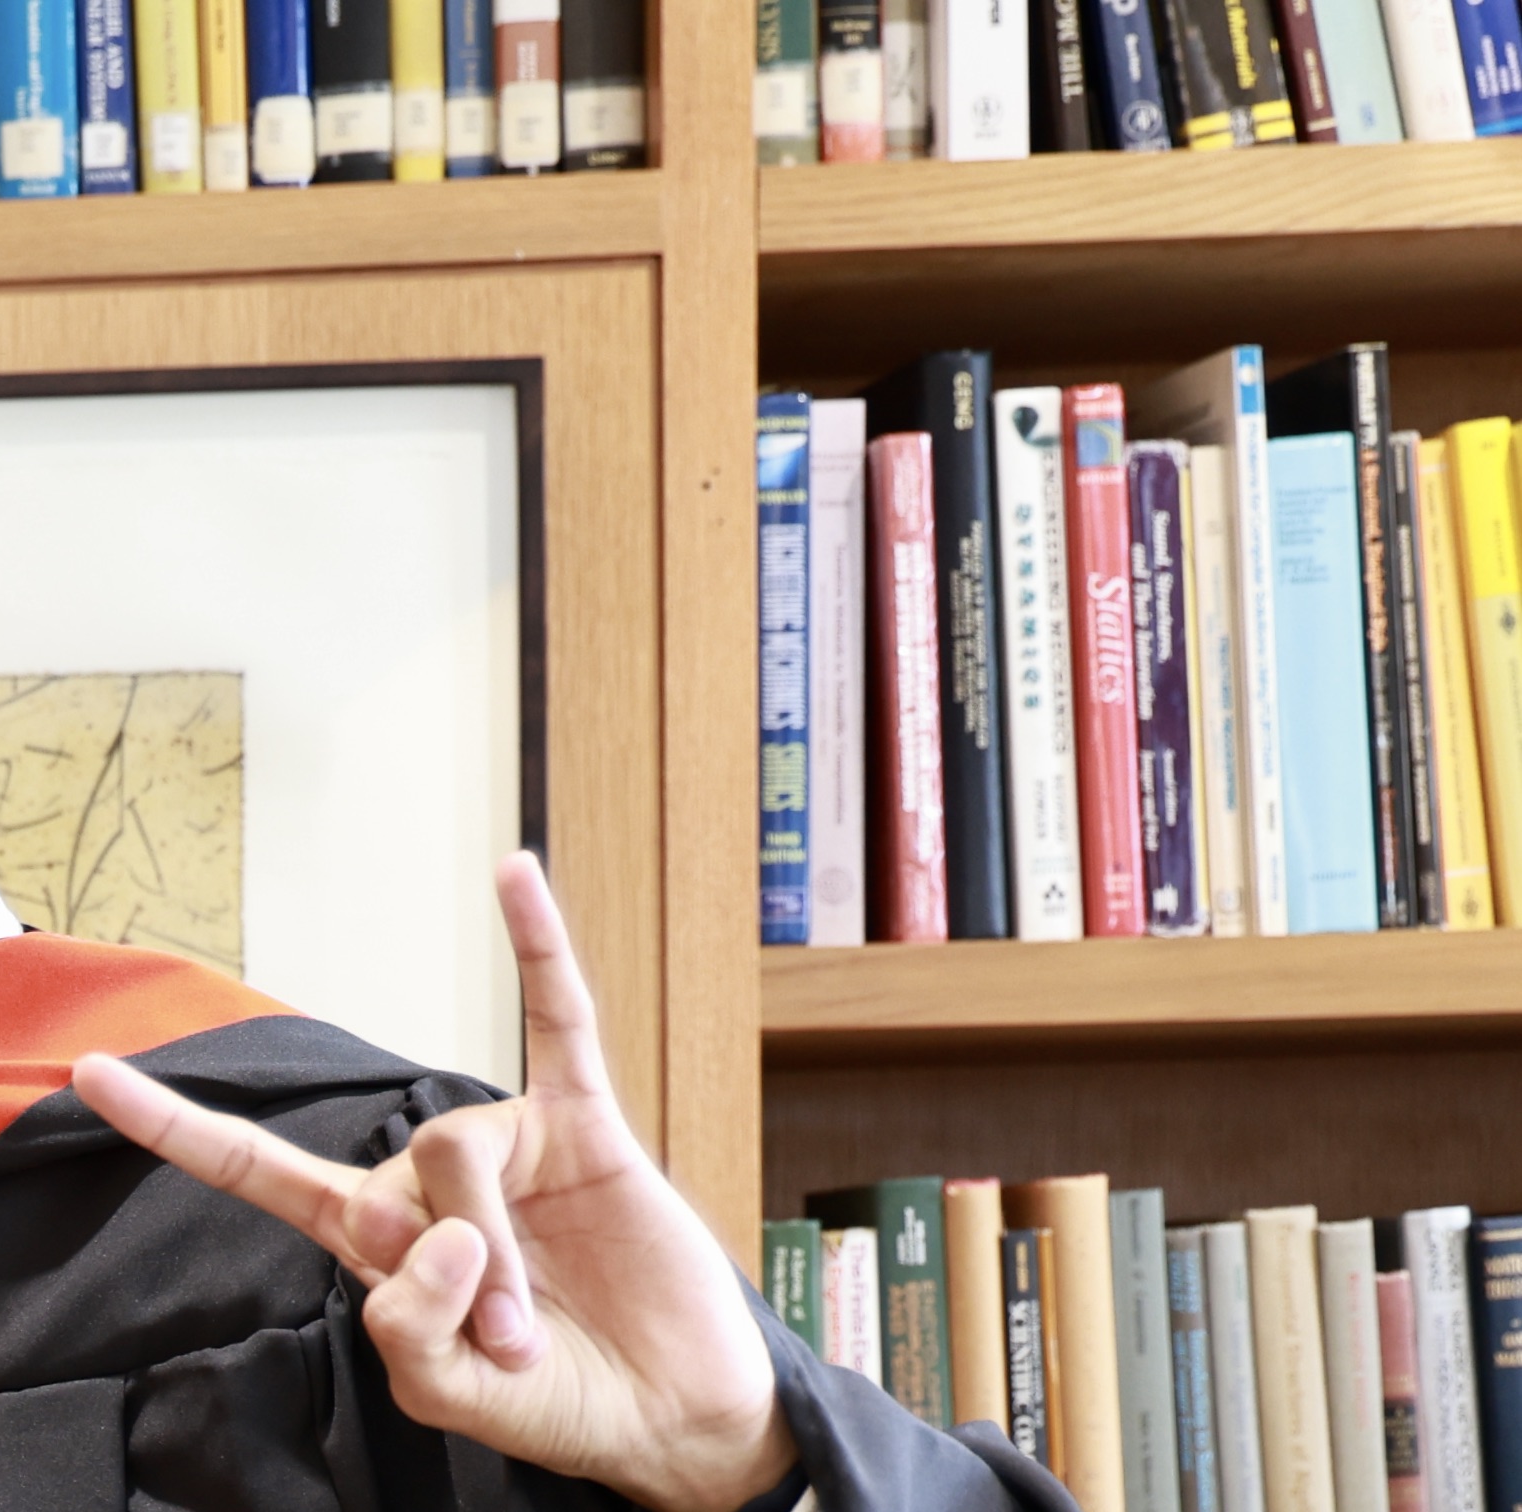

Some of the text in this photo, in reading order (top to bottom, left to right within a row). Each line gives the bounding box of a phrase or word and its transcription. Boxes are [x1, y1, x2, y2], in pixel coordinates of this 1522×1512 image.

[106, 44, 123, 89] AND
[1015, 505, 1041, 710] DYNAMICS
[1086, 571, 1129, 705] Statics
[1129, 543, 1156, 720] and Their Interaction
[1151, 511, 1176, 663] Sound, Structures,
[1050, 619, 1070, 756] MECHANICS
[791, 1304, 807, 1321] of
[849, 1243, 874, 1374] The Finite Ele
[1275, 1222, 1298, 1335] Fundamental
[1007, 1300, 1035, 1414] SCIENTIFIC
[1286, 1344, 1306, 1438] Structures
[1451, 1311, 1472, 1395] NUMERICAL
[1013, 1416, 1038, 1460] COM
[1290, 1446, 1307, 1465] of
[1456, 1403, 1476, 1477] METHODS
[1461, 1483, 1478, 1512] FOR
